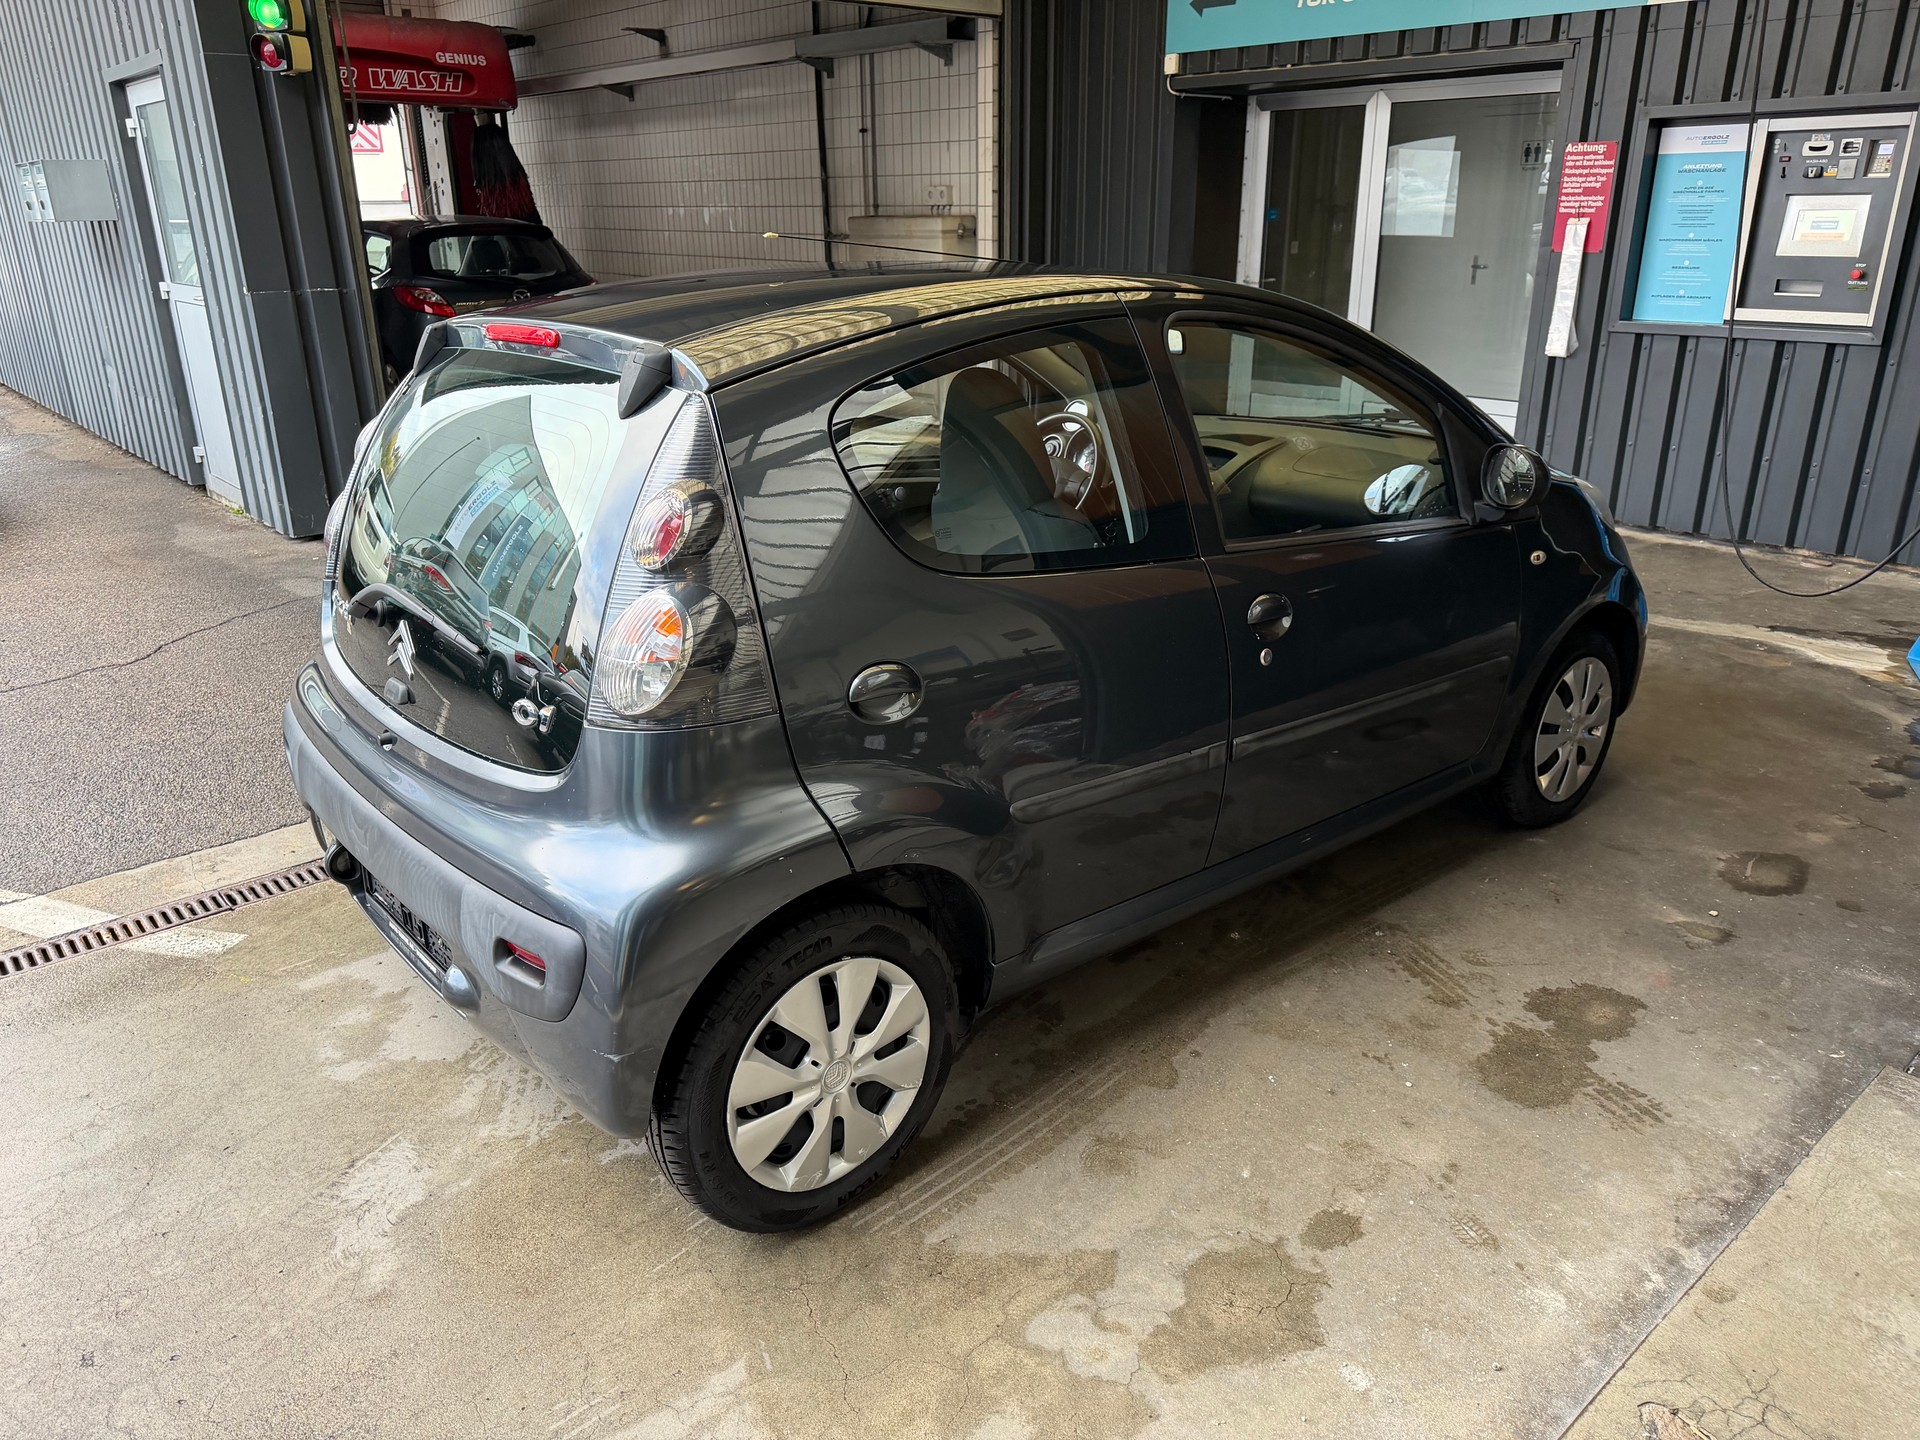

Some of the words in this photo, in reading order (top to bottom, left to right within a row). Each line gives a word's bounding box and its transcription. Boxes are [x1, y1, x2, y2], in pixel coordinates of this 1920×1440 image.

[435, 51, 487, 66] GENIUS
[368, 67, 463, 93] WASH
[1565, 143, 1607, 153] Achtung:
